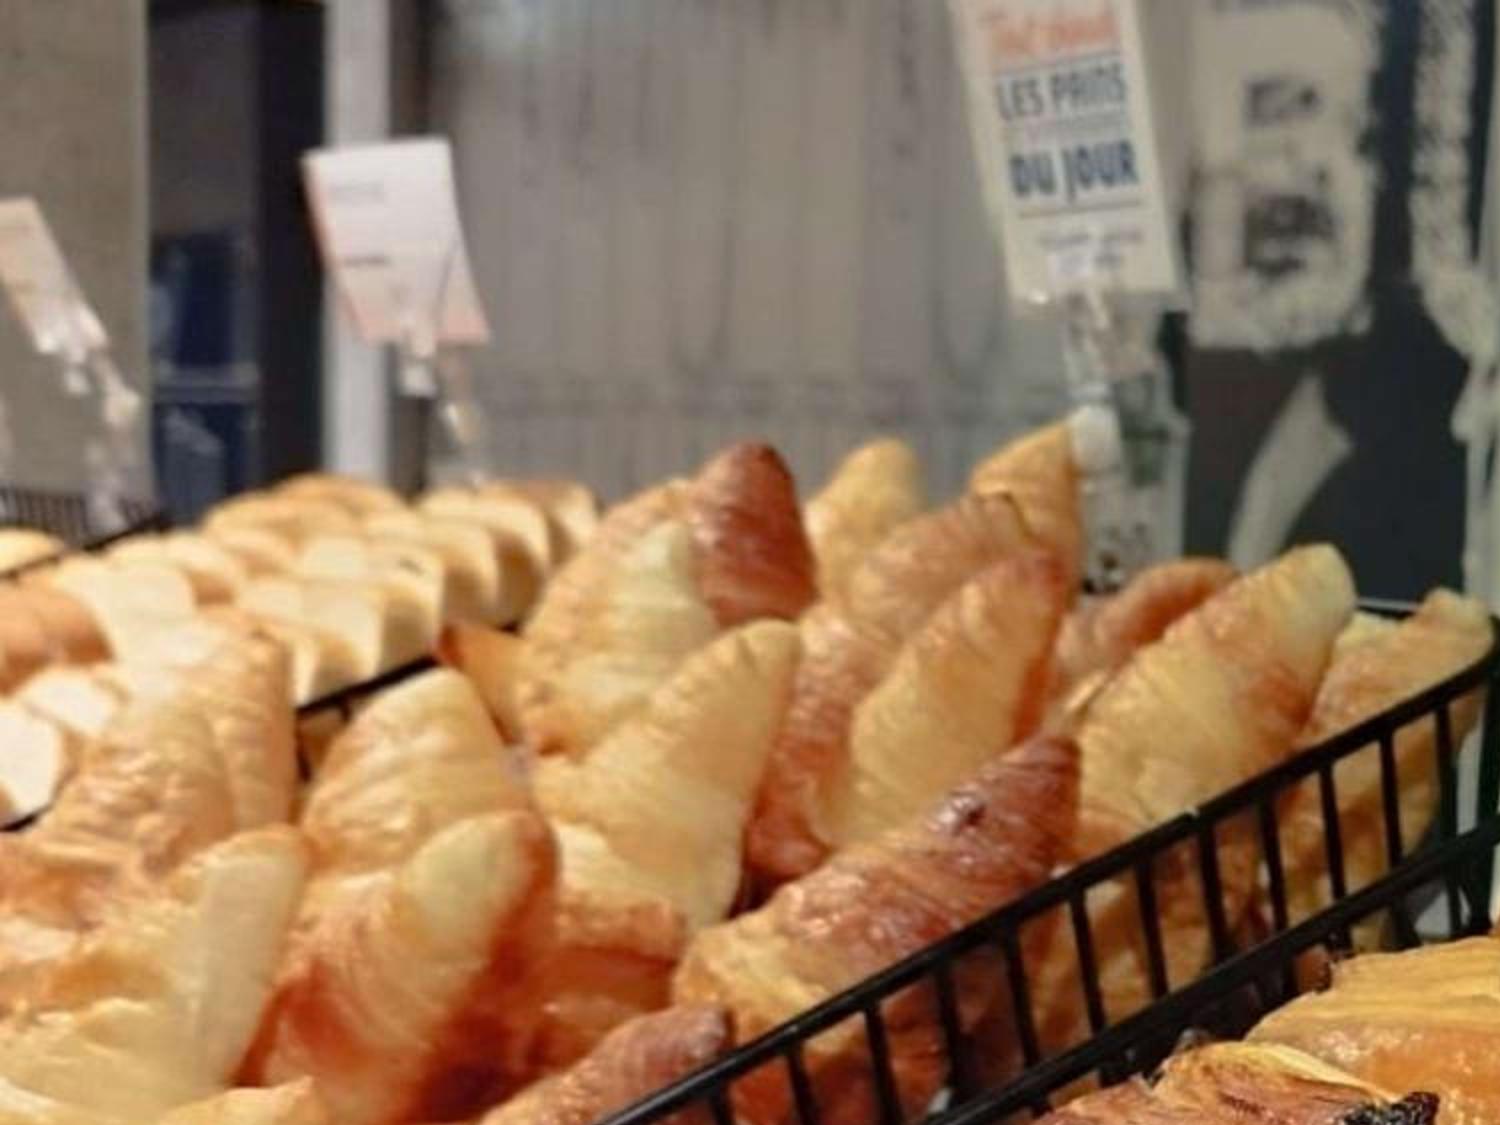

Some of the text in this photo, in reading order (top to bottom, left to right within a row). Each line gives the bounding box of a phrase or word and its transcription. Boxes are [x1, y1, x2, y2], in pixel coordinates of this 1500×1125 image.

[995, 77, 1044, 122] LES
[1008, 138, 1140, 203] DU JOUR
